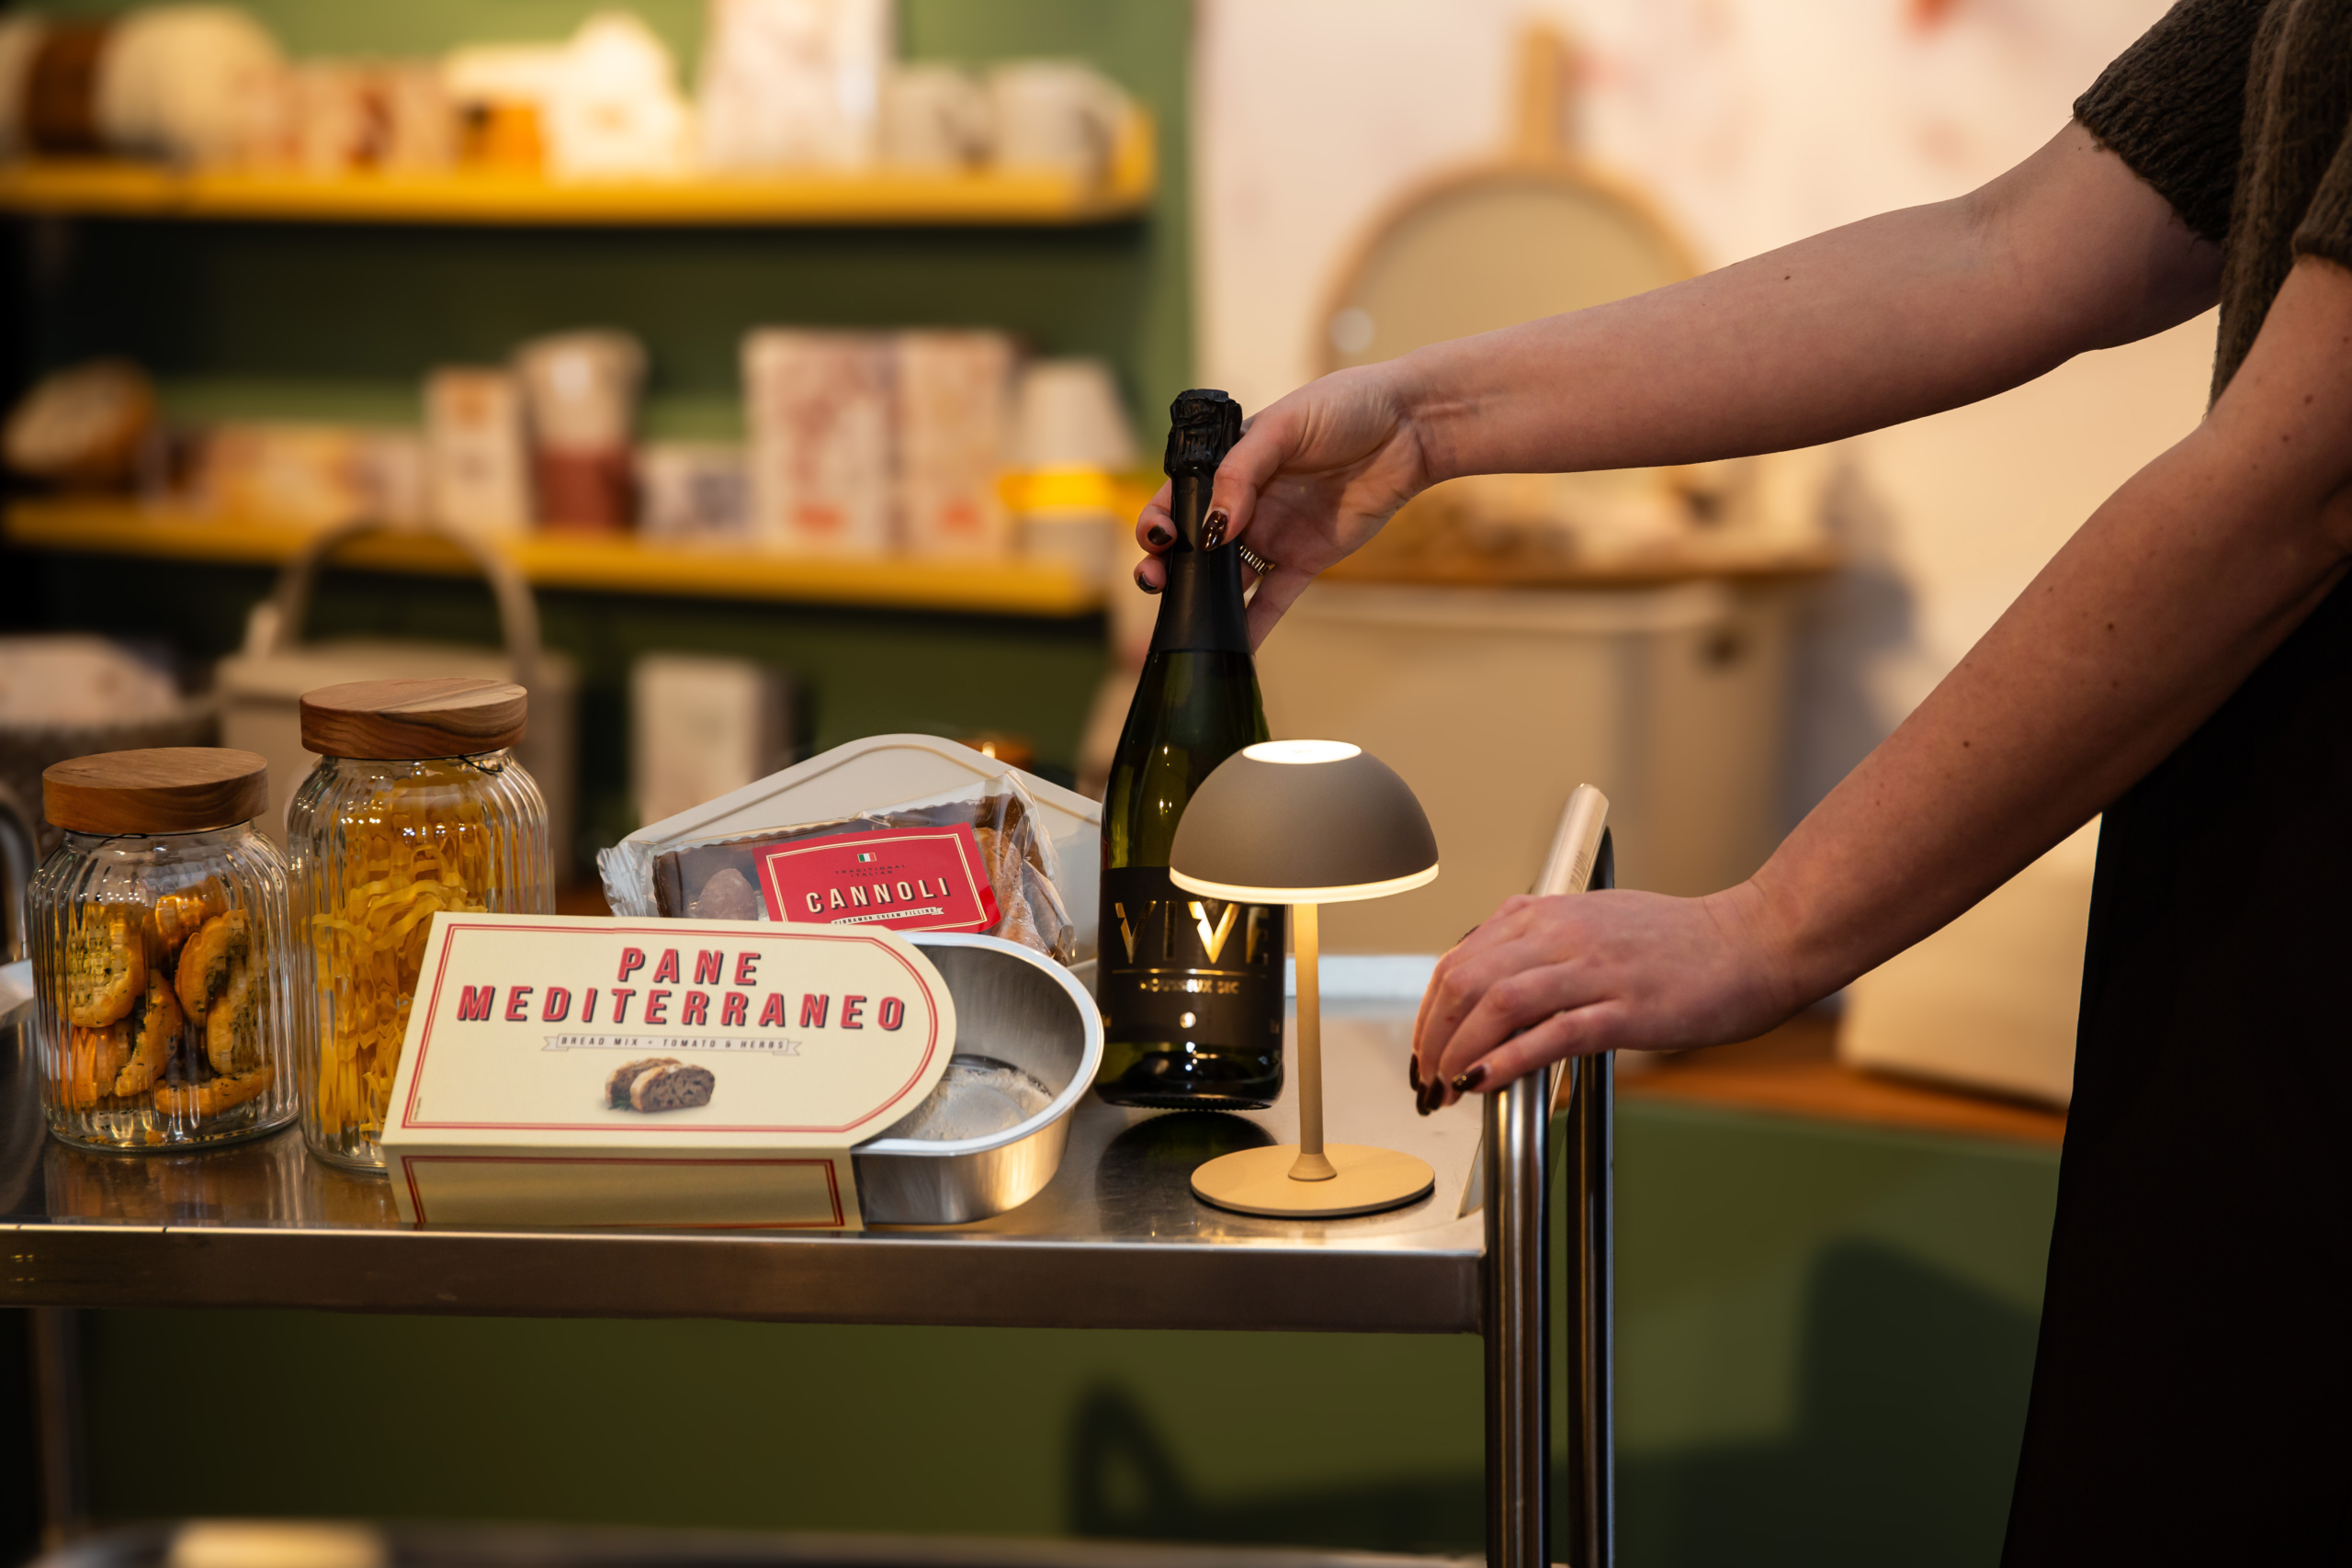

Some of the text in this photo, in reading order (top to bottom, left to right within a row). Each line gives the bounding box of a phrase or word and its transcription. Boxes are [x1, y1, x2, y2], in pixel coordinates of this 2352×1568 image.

[835, 864, 906, 874] TRADITIONAL
[851, 870, 893, 878] ITALIAN
[806, 877, 951, 915] CANNOLI
[834, 916, 873, 925] CINNAMON
[904, 908, 934, 916] FILLING
[617, 947, 762, 987] PANE
[456, 985, 905, 1032] MEDITERRANEO
[560, 1036, 605, 1045] BREAD
[614, 1037, 638, 1046] MIX
[662, 1038, 717, 1048] TOMATO
[740, 1040, 784, 1049] HERBS
